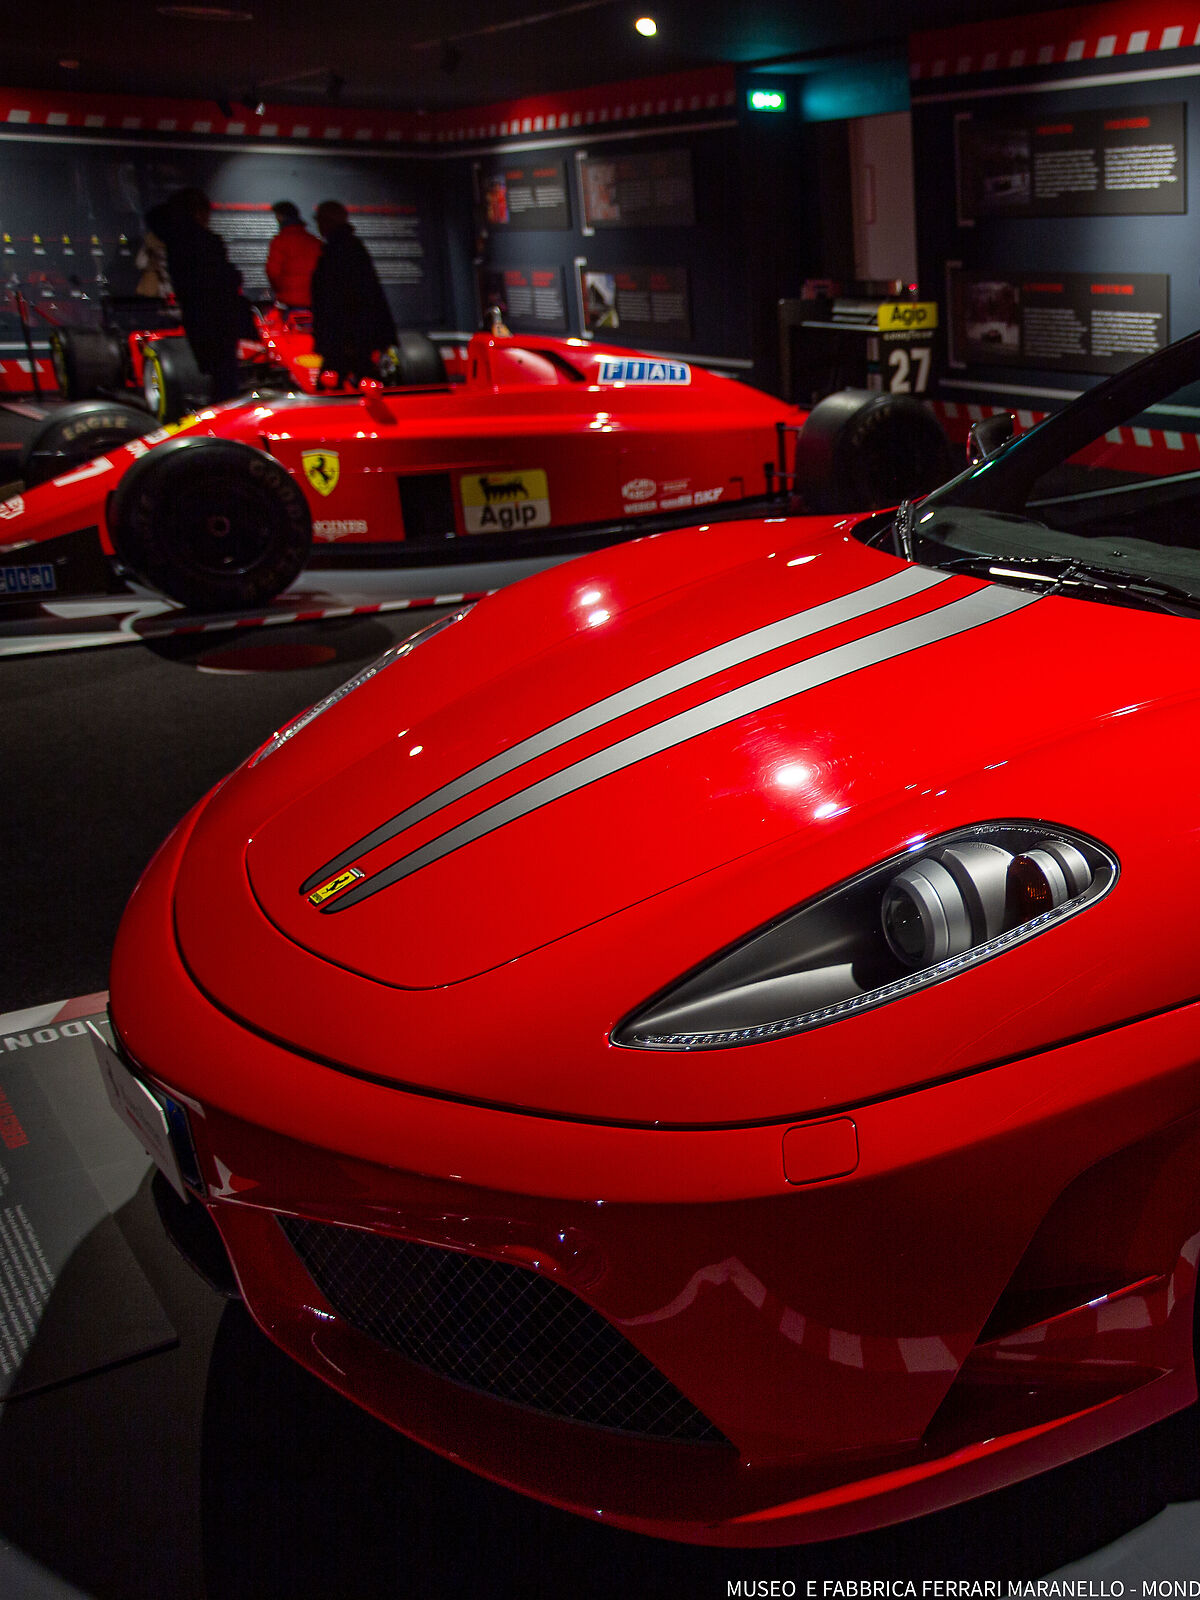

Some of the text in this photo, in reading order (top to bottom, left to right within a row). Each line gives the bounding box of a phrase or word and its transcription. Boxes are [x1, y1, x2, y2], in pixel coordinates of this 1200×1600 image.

[604, 362, 686, 380] FIAT
[888, 347, 933, 394] 27
[480, 502, 537, 528] Agip
